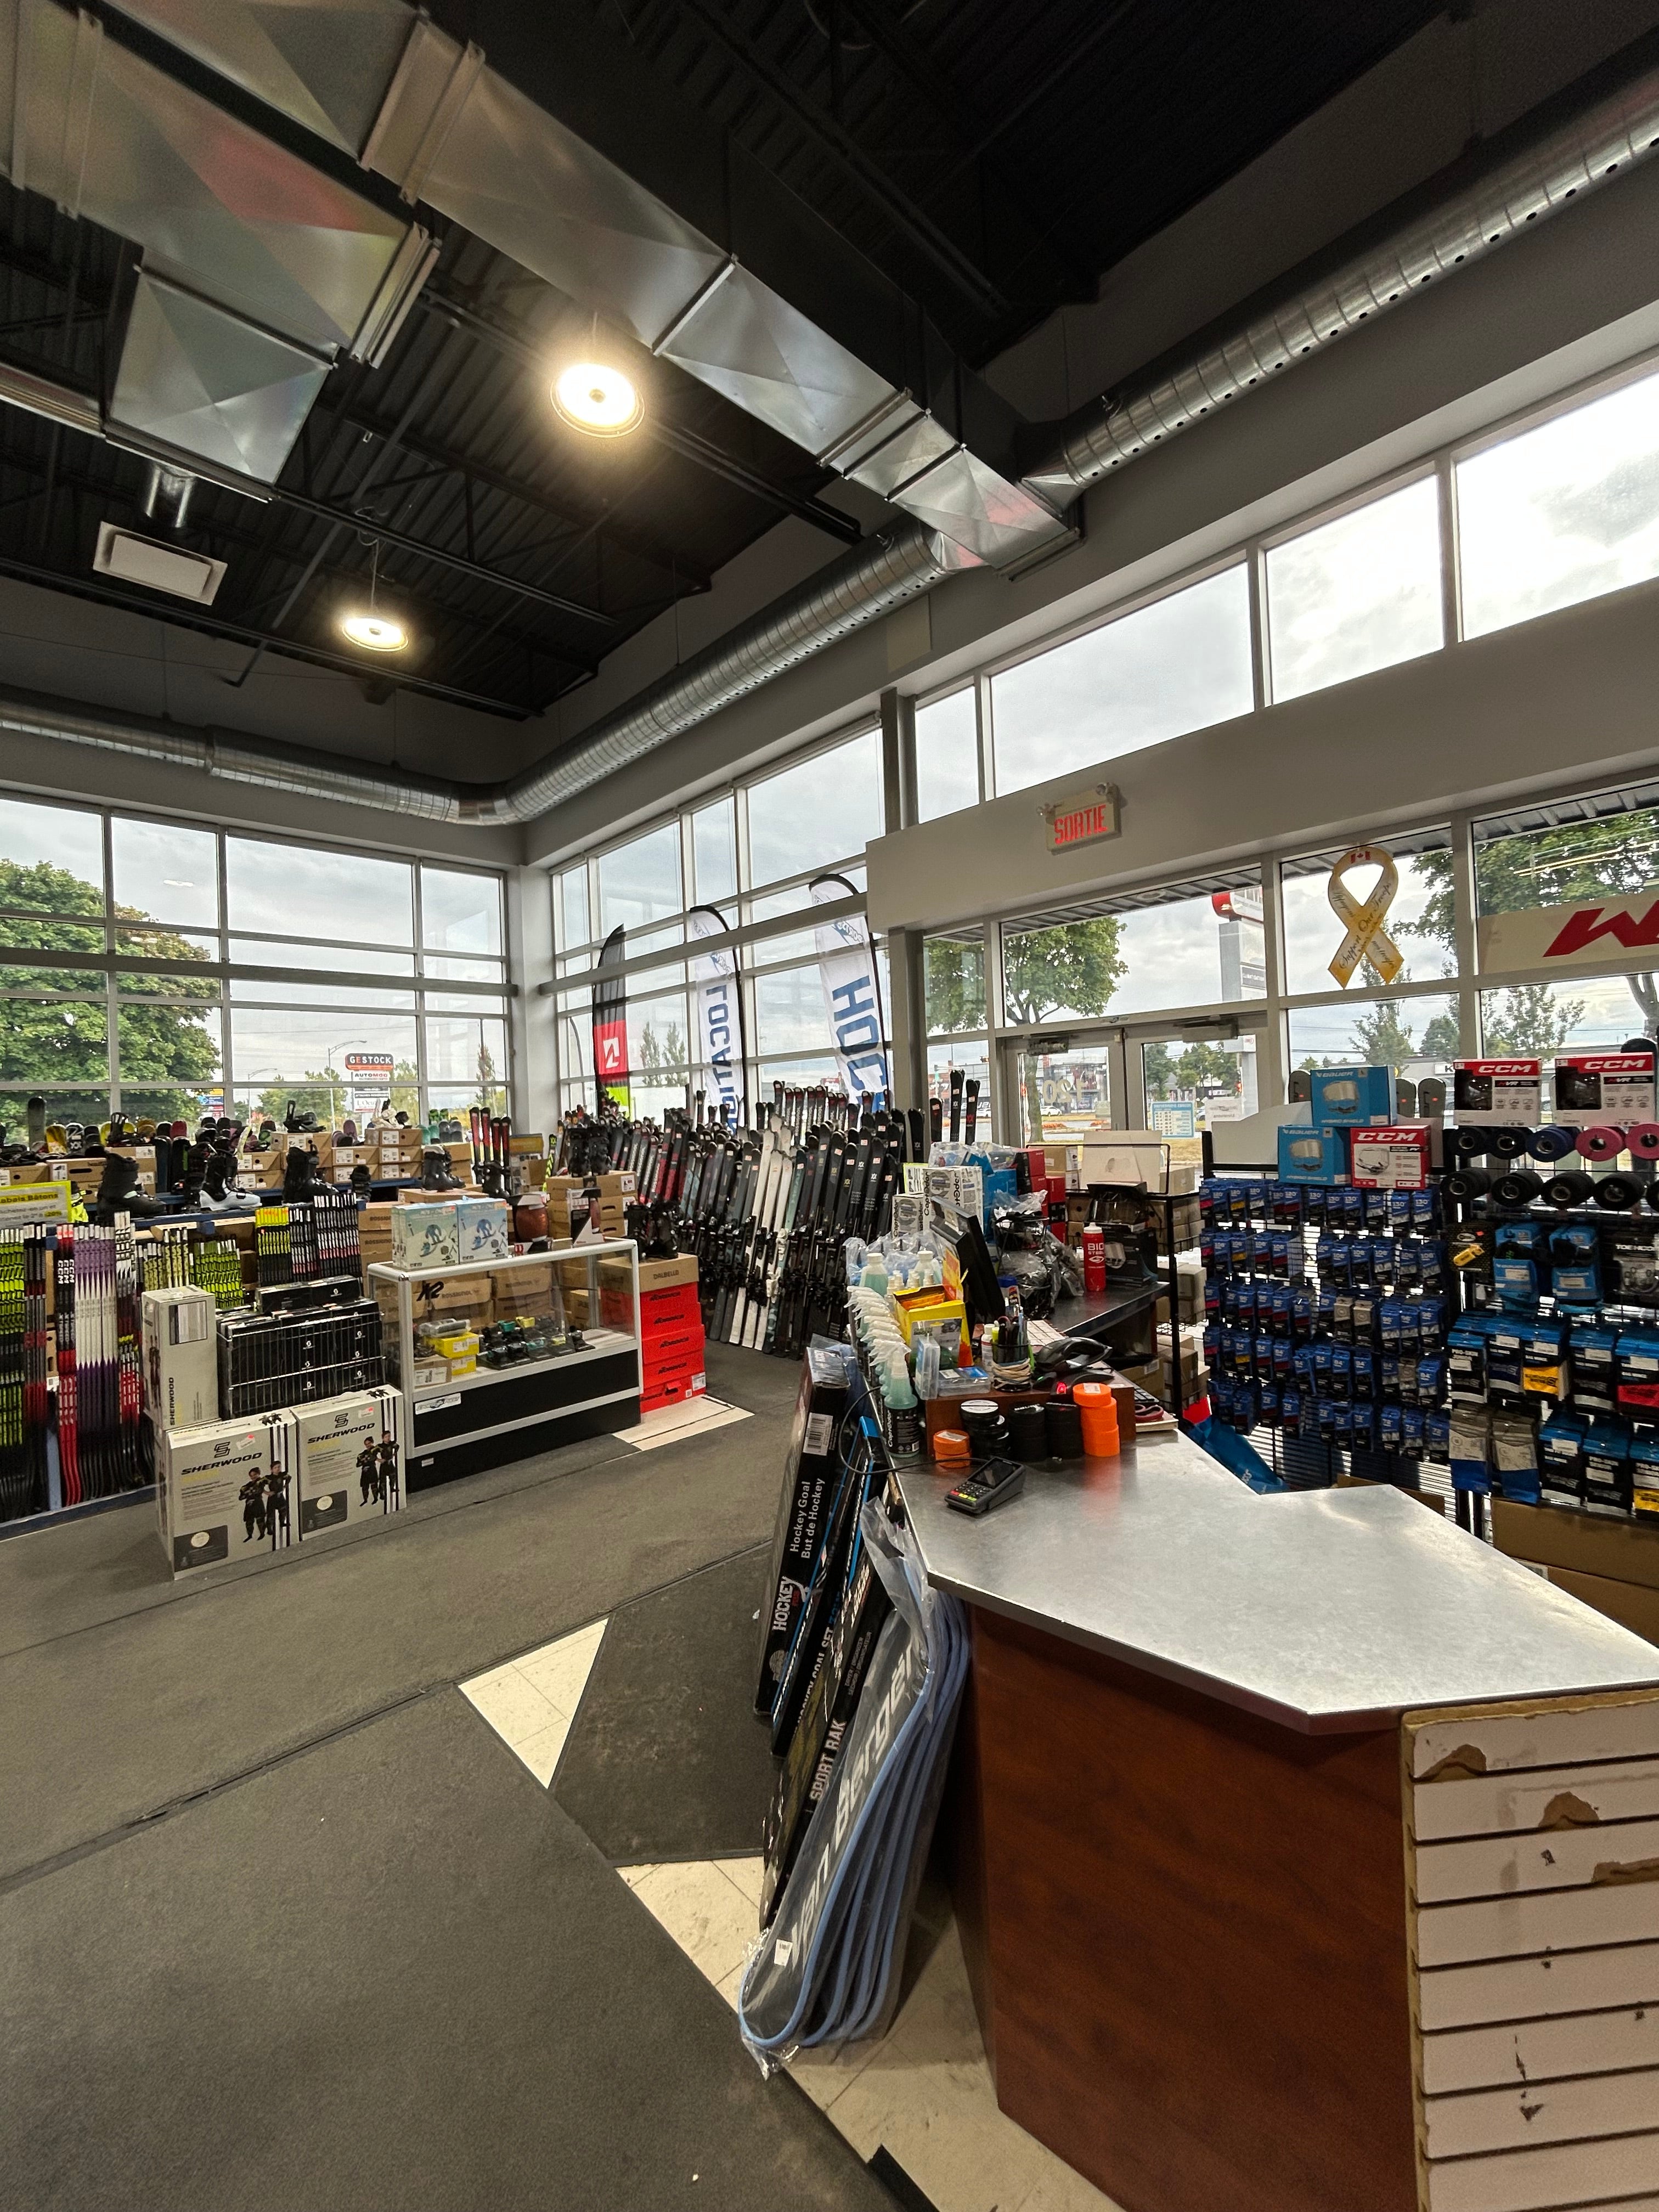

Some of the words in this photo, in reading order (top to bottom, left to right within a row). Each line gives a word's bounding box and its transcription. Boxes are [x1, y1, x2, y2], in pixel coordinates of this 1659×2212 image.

[1054, 804, 1107, 844] SORTIE
[1339, 934, 1361, 969] Support
[1358, 912, 1373, 932] Our
[1372, 882, 1391, 911] Troops
[1479, 1065, 1532, 1074] CCM
[1584, 1059, 1646, 1070] CCM
[1357, 1132, 1417, 1141] CCM
[653, 1270, 679, 1279] DALBELLO
[442, 1290, 472, 1299] ROSSIGNOL
[307, 1423, 375, 1444] SHERWOOD
[181, 1453, 262, 1475] SHERWOOD
[798, 1481, 810, 1508] Goal
[809, 1478, 825, 1520] Hockey
[790, 1510, 807, 1552] Hockey
[805, 1523, 816, 1538] de
[801, 1539, 813, 1559] But
[772, 1576, 800, 1631] HOCKEY
[822, 1627, 833, 1648] SET
[809, 1753, 835, 1801] SPORT
[825, 1718, 847, 1751] RAK
